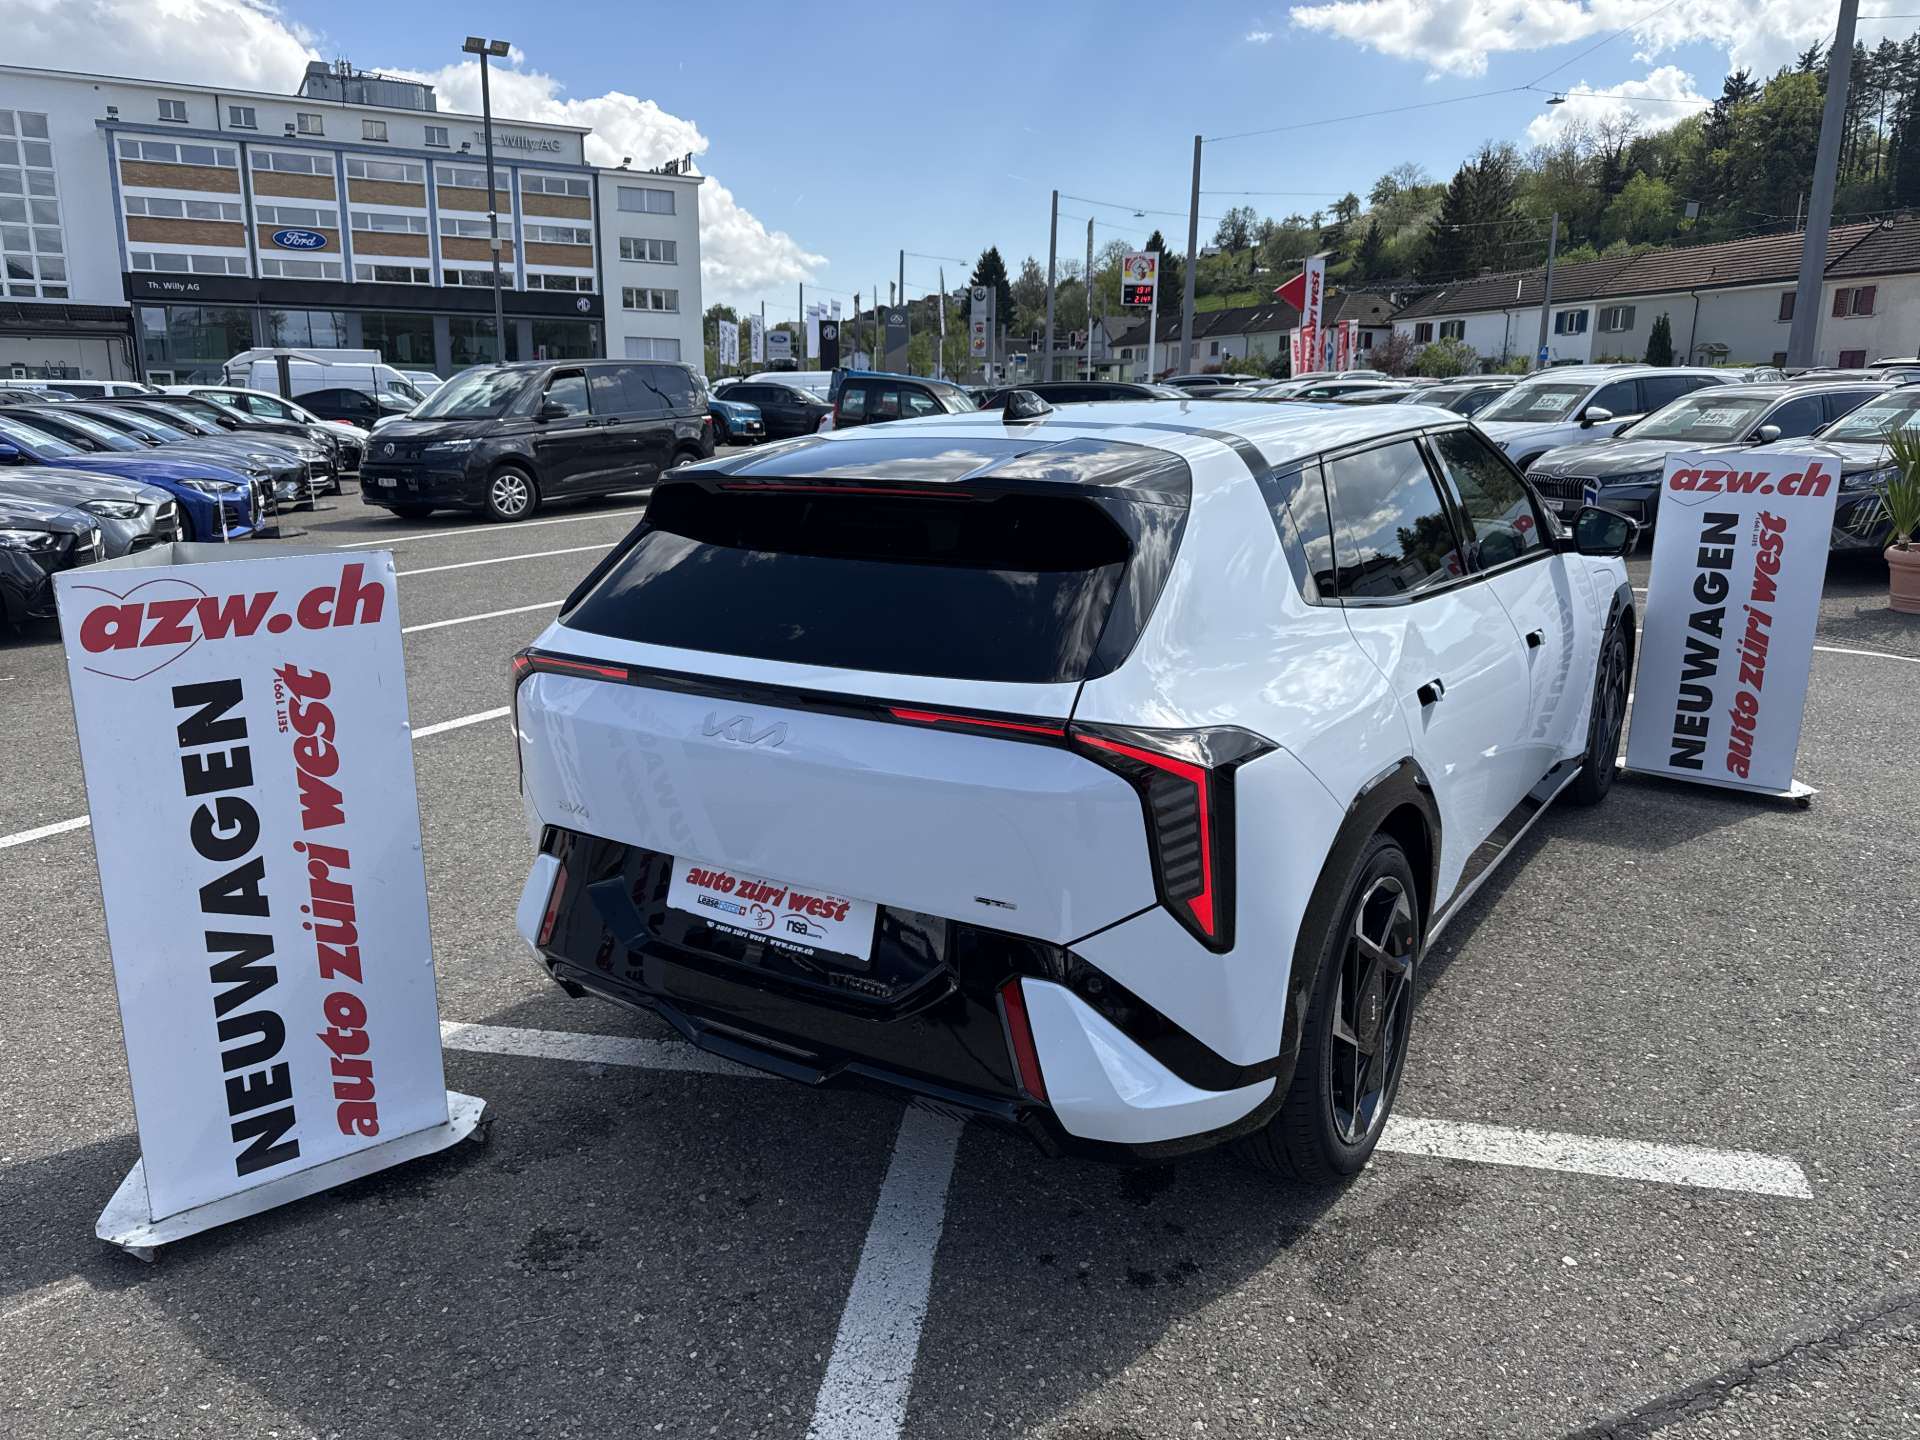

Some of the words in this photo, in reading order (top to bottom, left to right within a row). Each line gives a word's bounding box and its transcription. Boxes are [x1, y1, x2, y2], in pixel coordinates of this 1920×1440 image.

[540, 137, 561, 153] AG
[282, 231, 317, 247] Ford
[1882, 219, 1894, 229] 48
[147, 281, 161, 289] Th.
[163, 282, 185, 292] Willy
[186, 283, 200, 291] AG
[1669, 462, 1832, 497] azw.ch
[1751, 510, 1787, 603] west
[80, 563, 386, 654] azw.ch
[1669, 511, 1740, 771] NEUWAGEN
[1737, 604, 1773, 693] züri
[273, 678, 285, 706] 1991
[276, 709, 289, 733] SEIT
[701, 711, 788, 748] KIA
[1726, 690, 1760, 779] auto
[272, 662, 344, 831] west
[293, 840, 363, 985] züri
[686, 868, 736, 894] auto
[735, 879, 789, 908] züri
[787, 892, 851, 922] west
[171, 677, 302, 1179] NEUWAGEN
[715, 923, 732, 934] auto
[732, 927, 748, 939] züri
[749, 932, 767, 944] west
[786, 919, 808, 935] nsa
[315, 990, 379, 1138] auto
